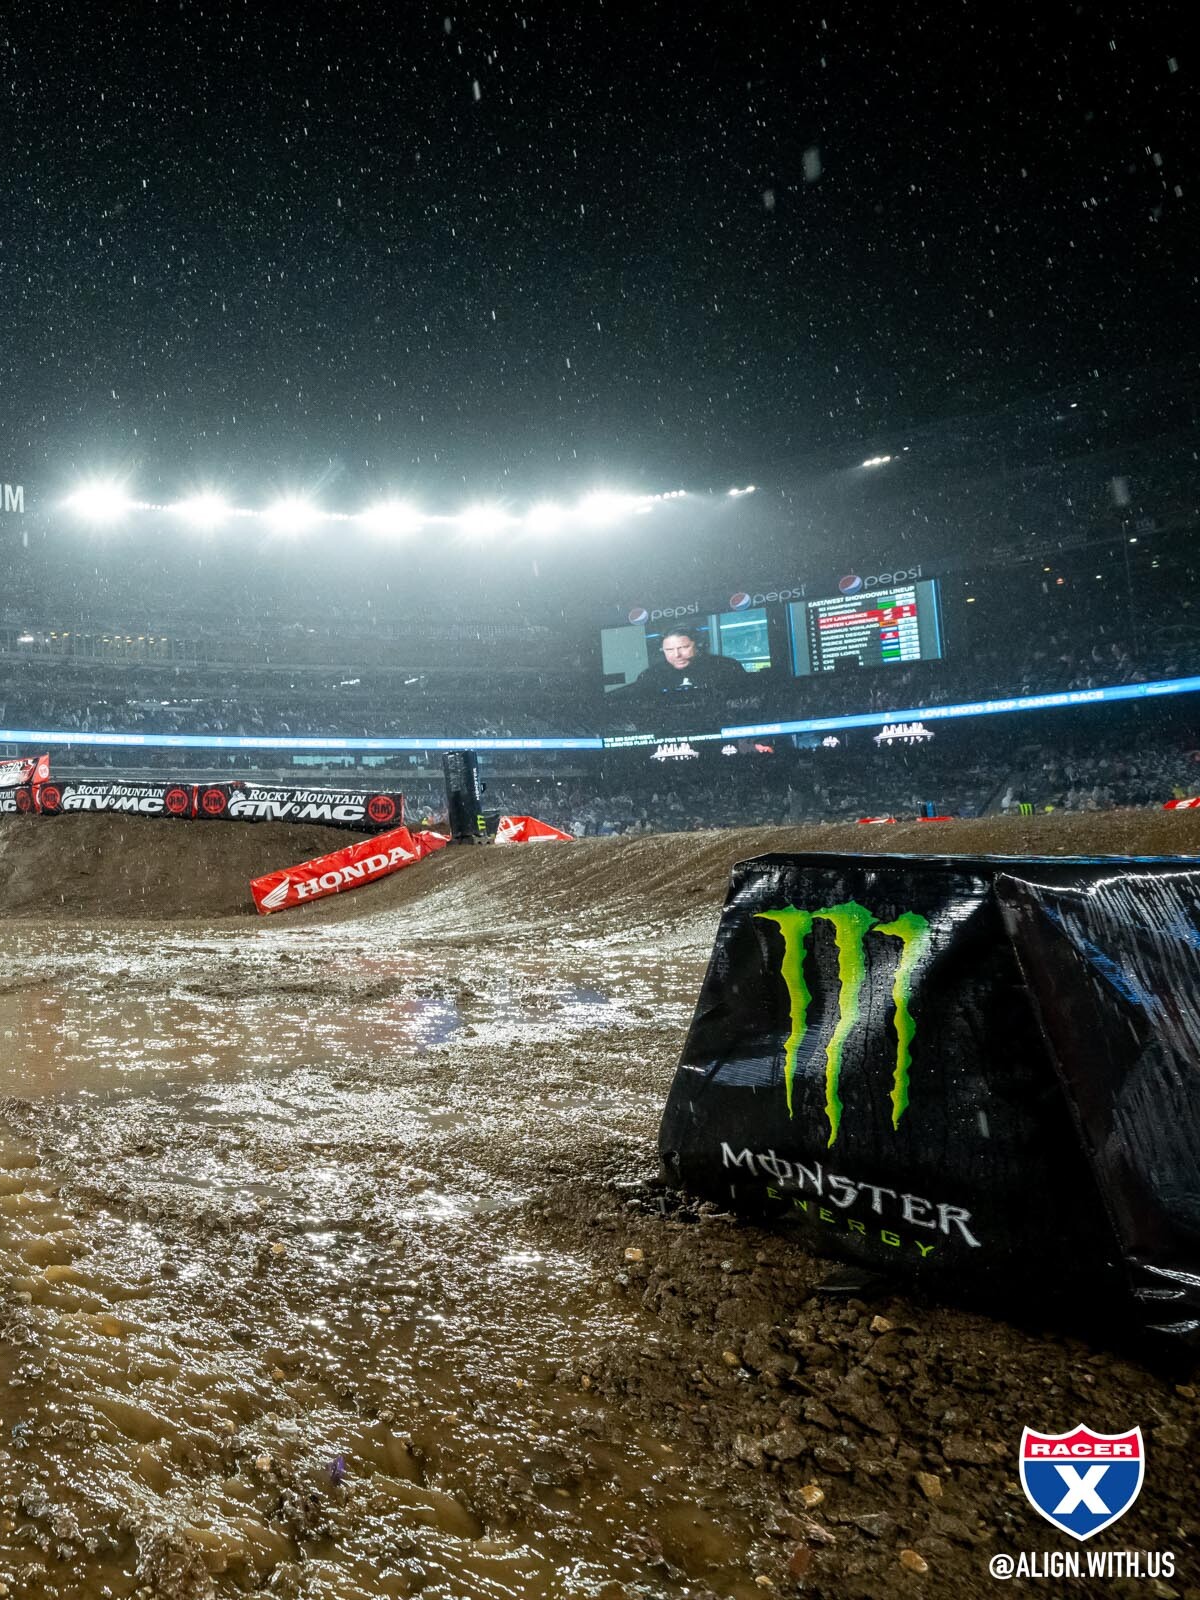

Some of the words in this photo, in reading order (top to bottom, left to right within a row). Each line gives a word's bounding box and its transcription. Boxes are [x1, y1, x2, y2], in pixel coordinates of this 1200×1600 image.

[864, 566, 922, 590] pepsi
[750, 584, 806, 608] pepsi
[845, 590, 888, 602] SHOWDOWN
[889, 586, 915, 595] LINEUP
[650, 602, 699, 622] pepsi
[919, 708, 948, 719] LOVE
[950, 705, 984, 715] MOTO
[986, 702, 1016, 711] STOP
[1019, 695, 1068, 707] CANCER
[1070, 691, 1103, 701] RACE
[77, 785, 108, 795] ROCKY
[109, 786, 165, 797] MOUNTAIN
[249, 790, 289, 801] ROCKY
[293, 791, 366, 805] MOUNTAIN
[294, 846, 414, 900] HONDA
[720, 1142, 982, 1250] MONSTER
[767, 1186, 935, 1258] ENERGY
